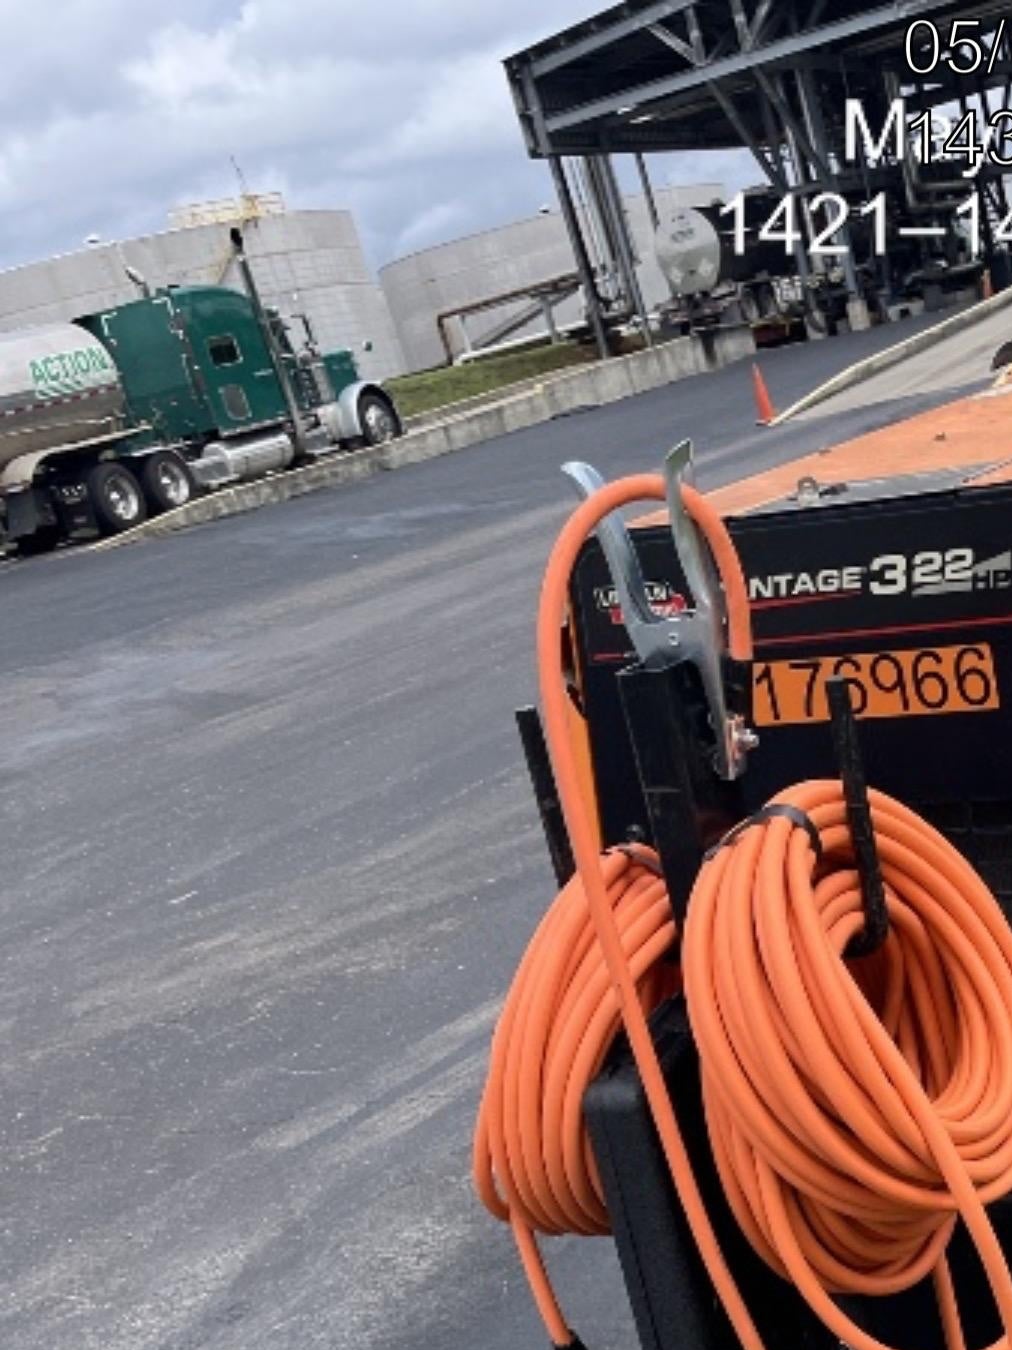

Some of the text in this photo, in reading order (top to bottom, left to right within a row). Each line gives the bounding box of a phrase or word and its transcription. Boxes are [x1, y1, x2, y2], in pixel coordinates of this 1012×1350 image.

[29, 346, 109, 384] ACTION
[721, 566, 867, 600] NTAGE
[755, 648, 991, 721] 176966
